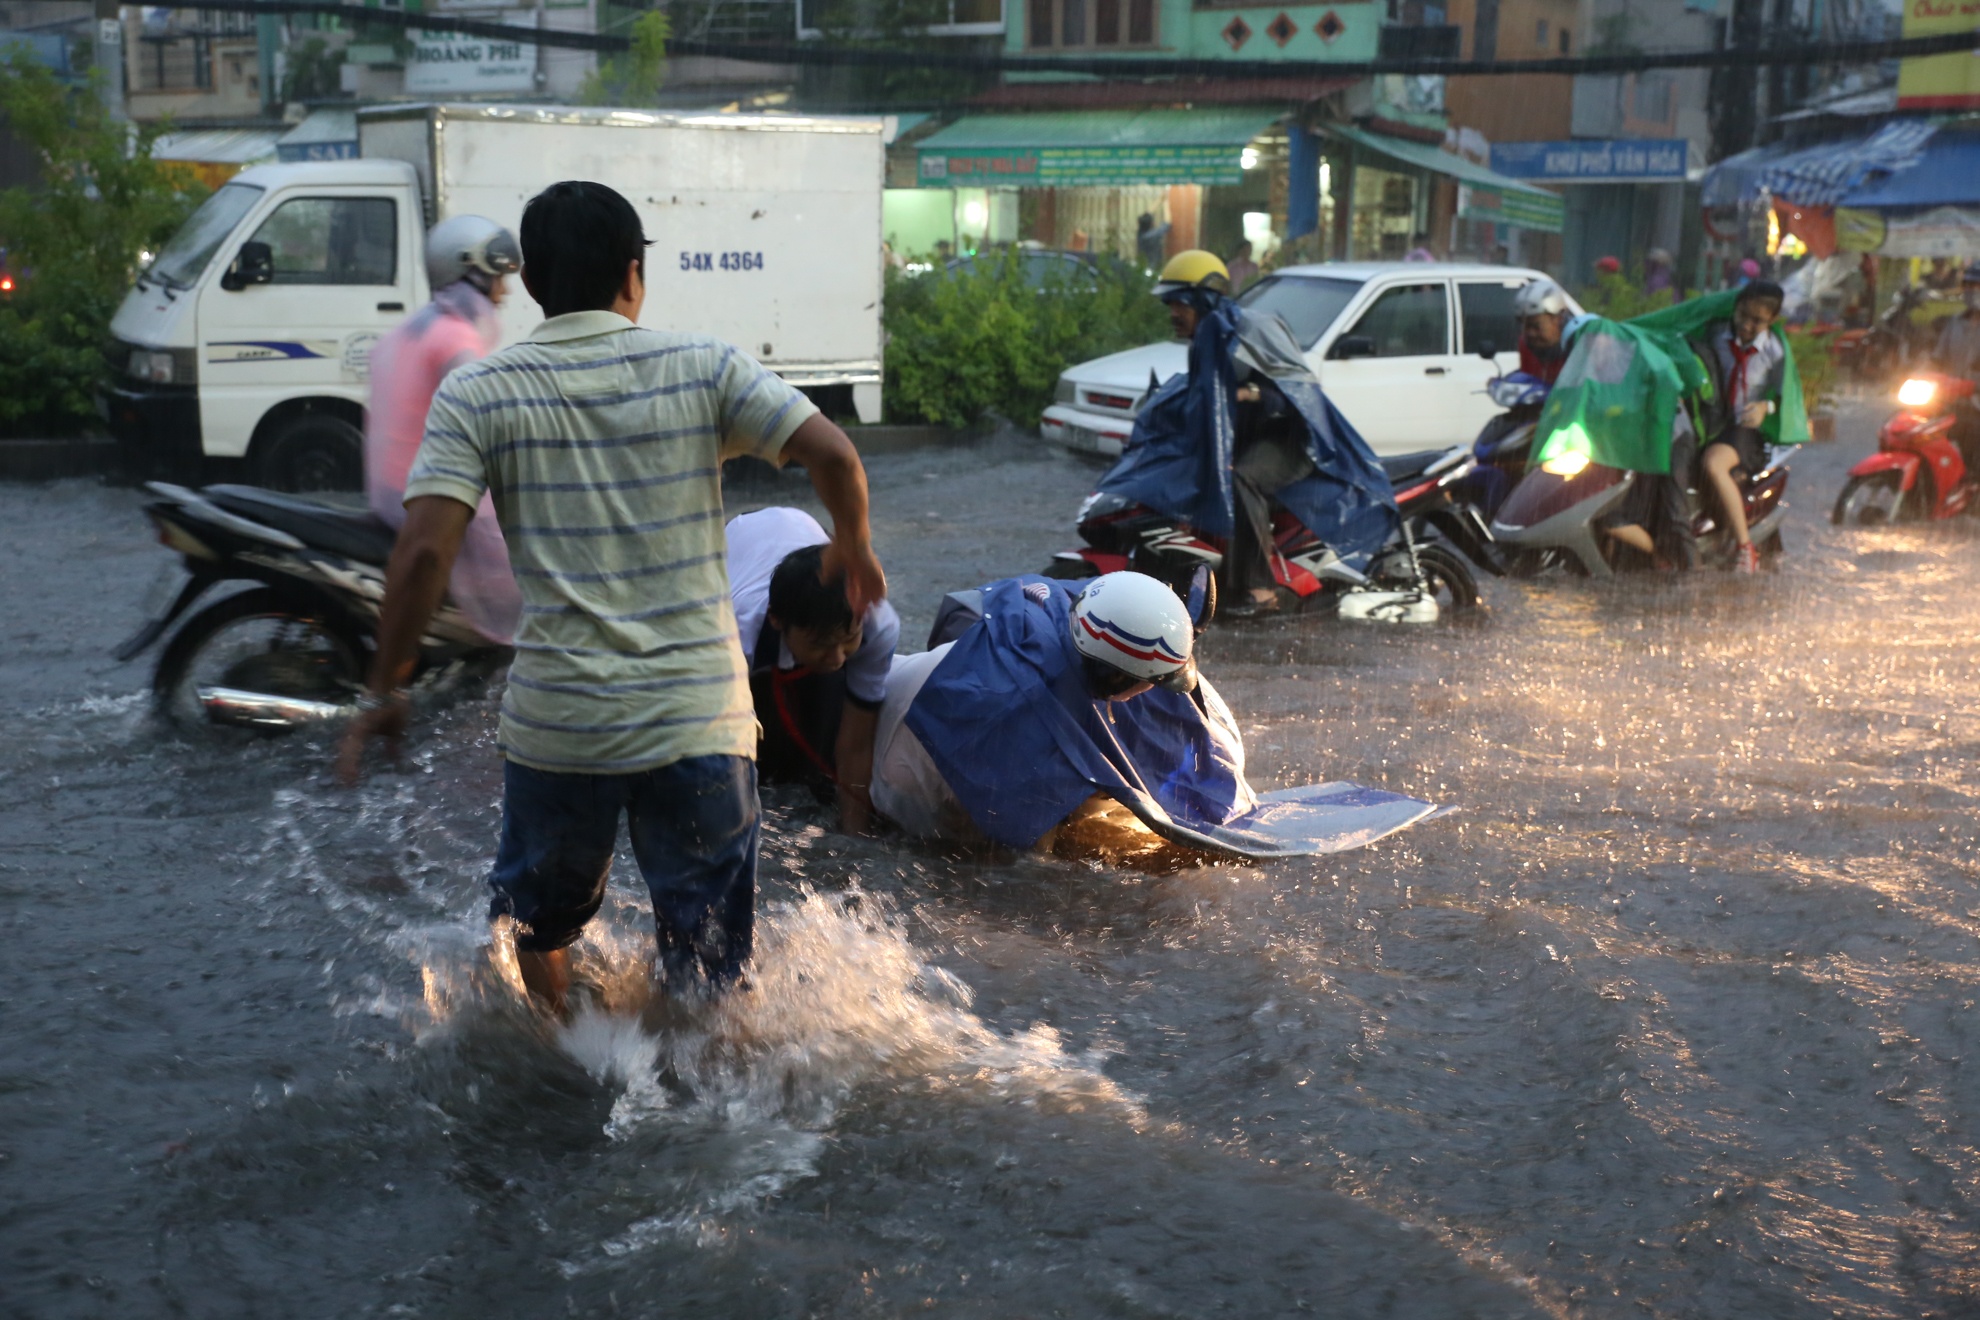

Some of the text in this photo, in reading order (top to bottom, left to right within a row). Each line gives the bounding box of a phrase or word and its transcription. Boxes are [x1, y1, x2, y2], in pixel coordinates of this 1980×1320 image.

[416, 41, 482, 62] HOÀNG
[680, 252, 763, 271] 54X 4364
